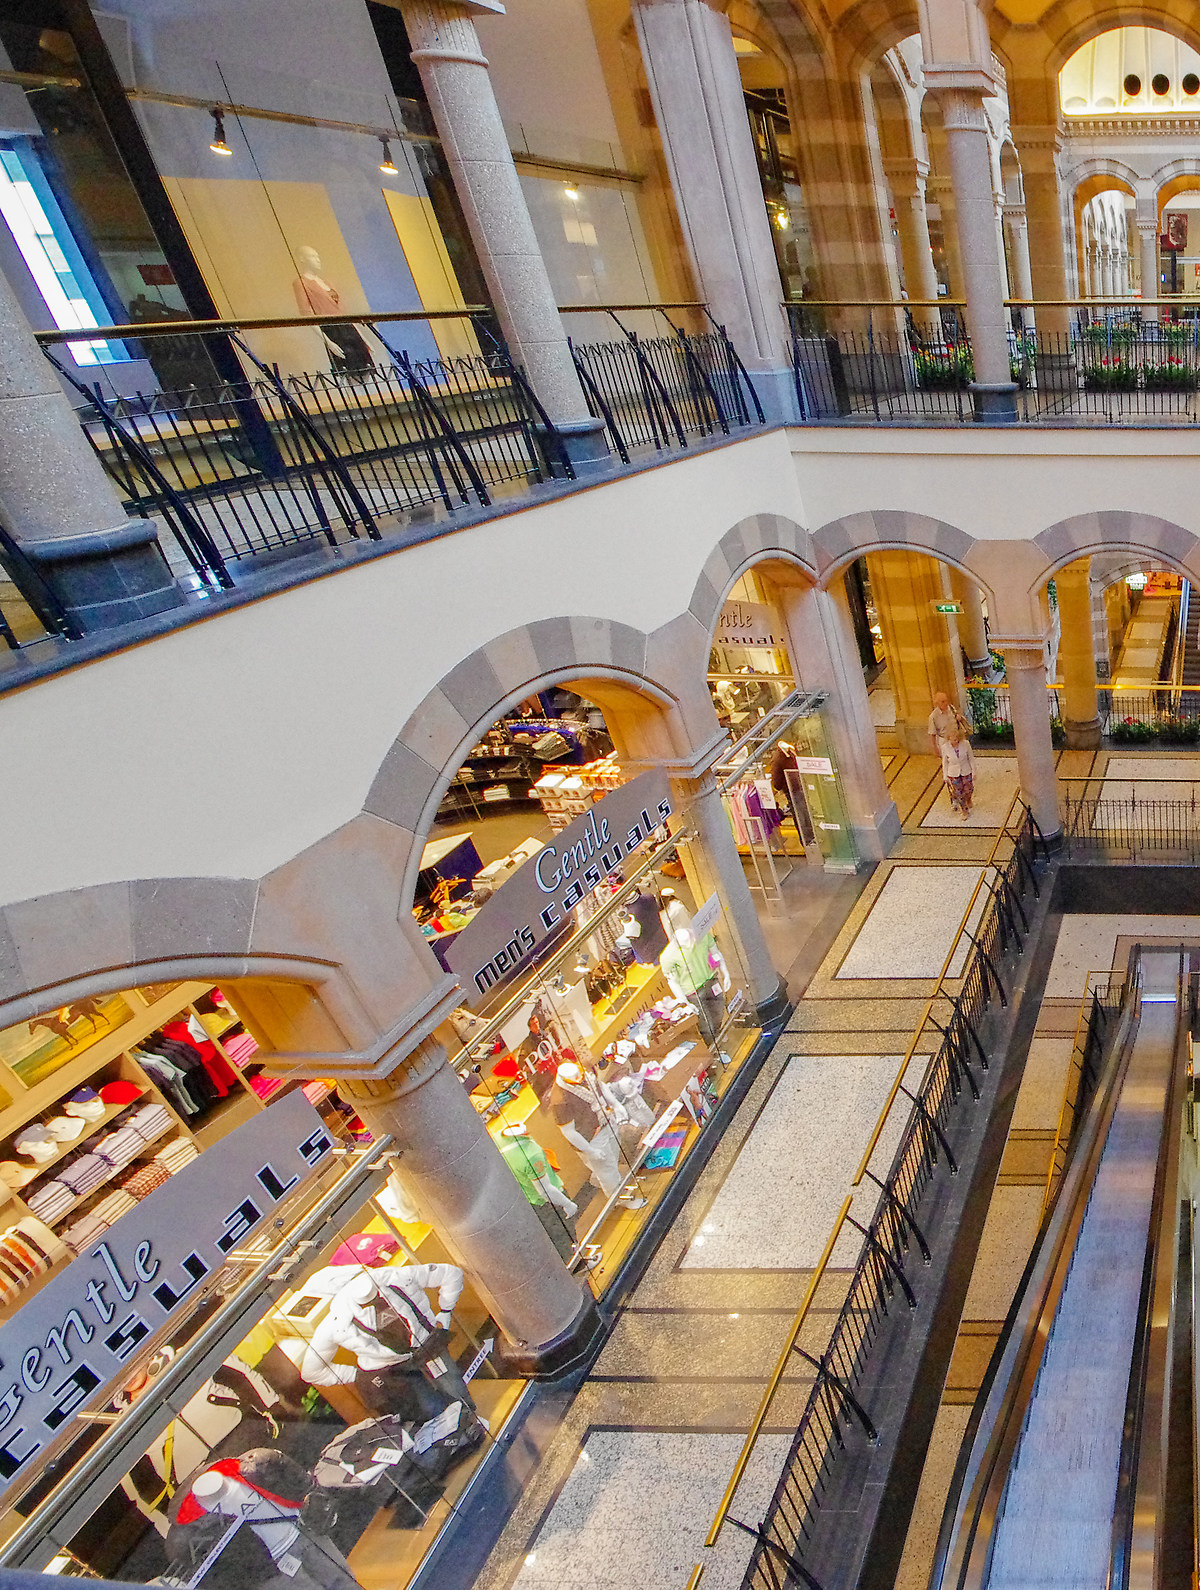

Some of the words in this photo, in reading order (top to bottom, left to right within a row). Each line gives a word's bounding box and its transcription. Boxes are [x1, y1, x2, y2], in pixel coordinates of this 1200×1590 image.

[718, 634, 785, 645] asuals
[720, 604, 752, 628] ntle
[535, 810, 611, 893] Gentle
[473, 925, 536, 995] men's
